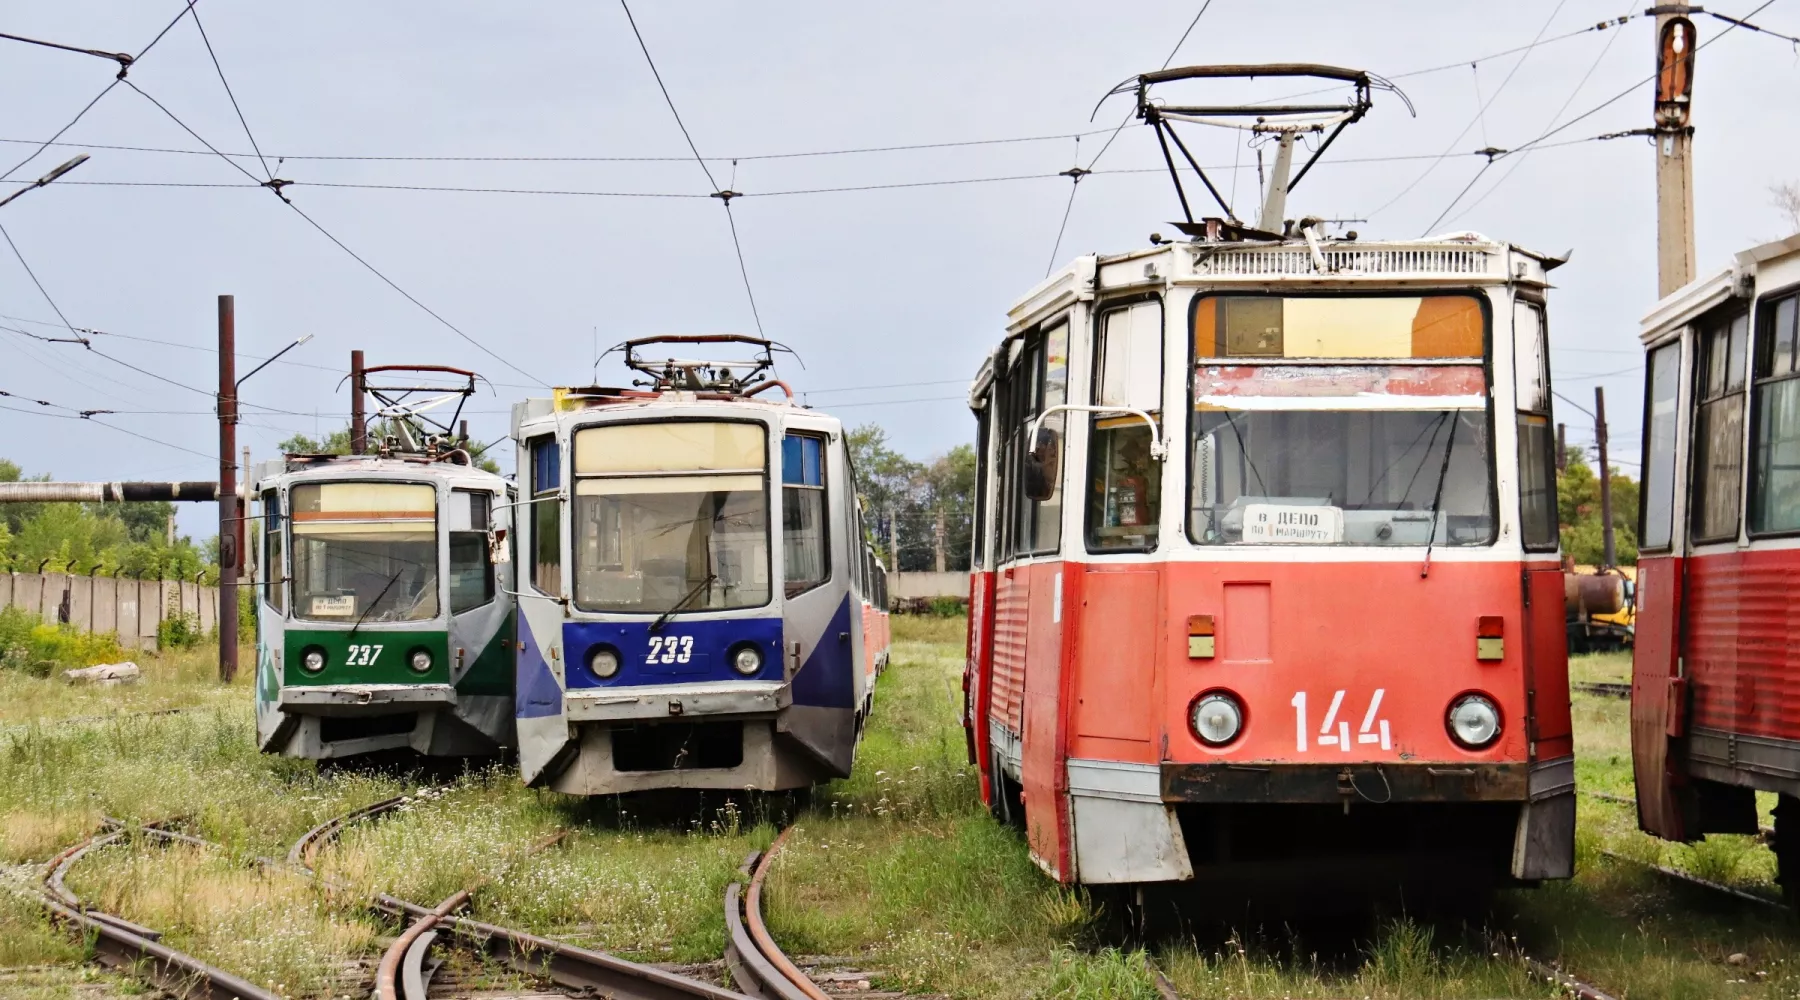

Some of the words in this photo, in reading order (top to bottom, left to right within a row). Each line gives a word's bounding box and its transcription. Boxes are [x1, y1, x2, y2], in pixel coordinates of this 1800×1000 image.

[1258, 512, 1267, 522] В
[1277, 511, 1319, 526] ДЕПО
[1251, 525, 1264, 535] ПО
[1275, 527, 1329, 540] МАРШРУТУ
[345, 644, 384, 666] 237
[645, 636, 694, 665] 233
[1290, 688, 1392, 753] 144
